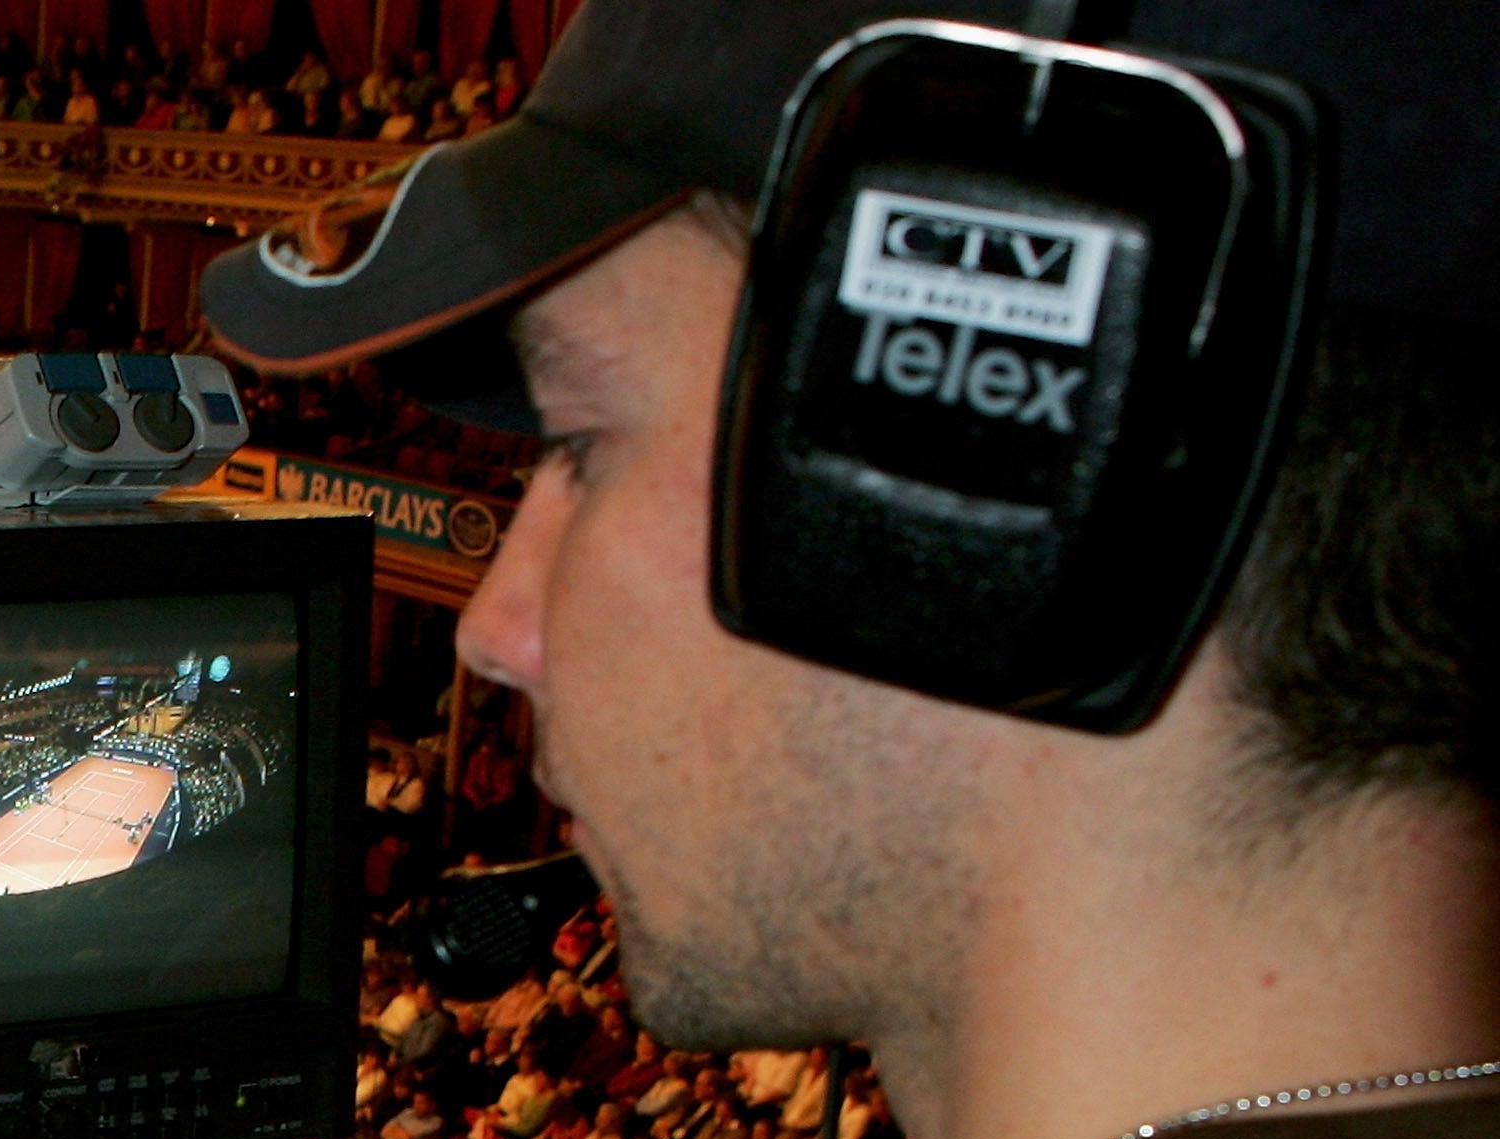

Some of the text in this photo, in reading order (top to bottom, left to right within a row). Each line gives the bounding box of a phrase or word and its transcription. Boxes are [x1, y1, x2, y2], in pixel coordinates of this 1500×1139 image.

[884, 214, 1073, 279] CTV
[853, 314, 1087, 434] Telex
[309, 472, 444, 538] BARCLAYS
